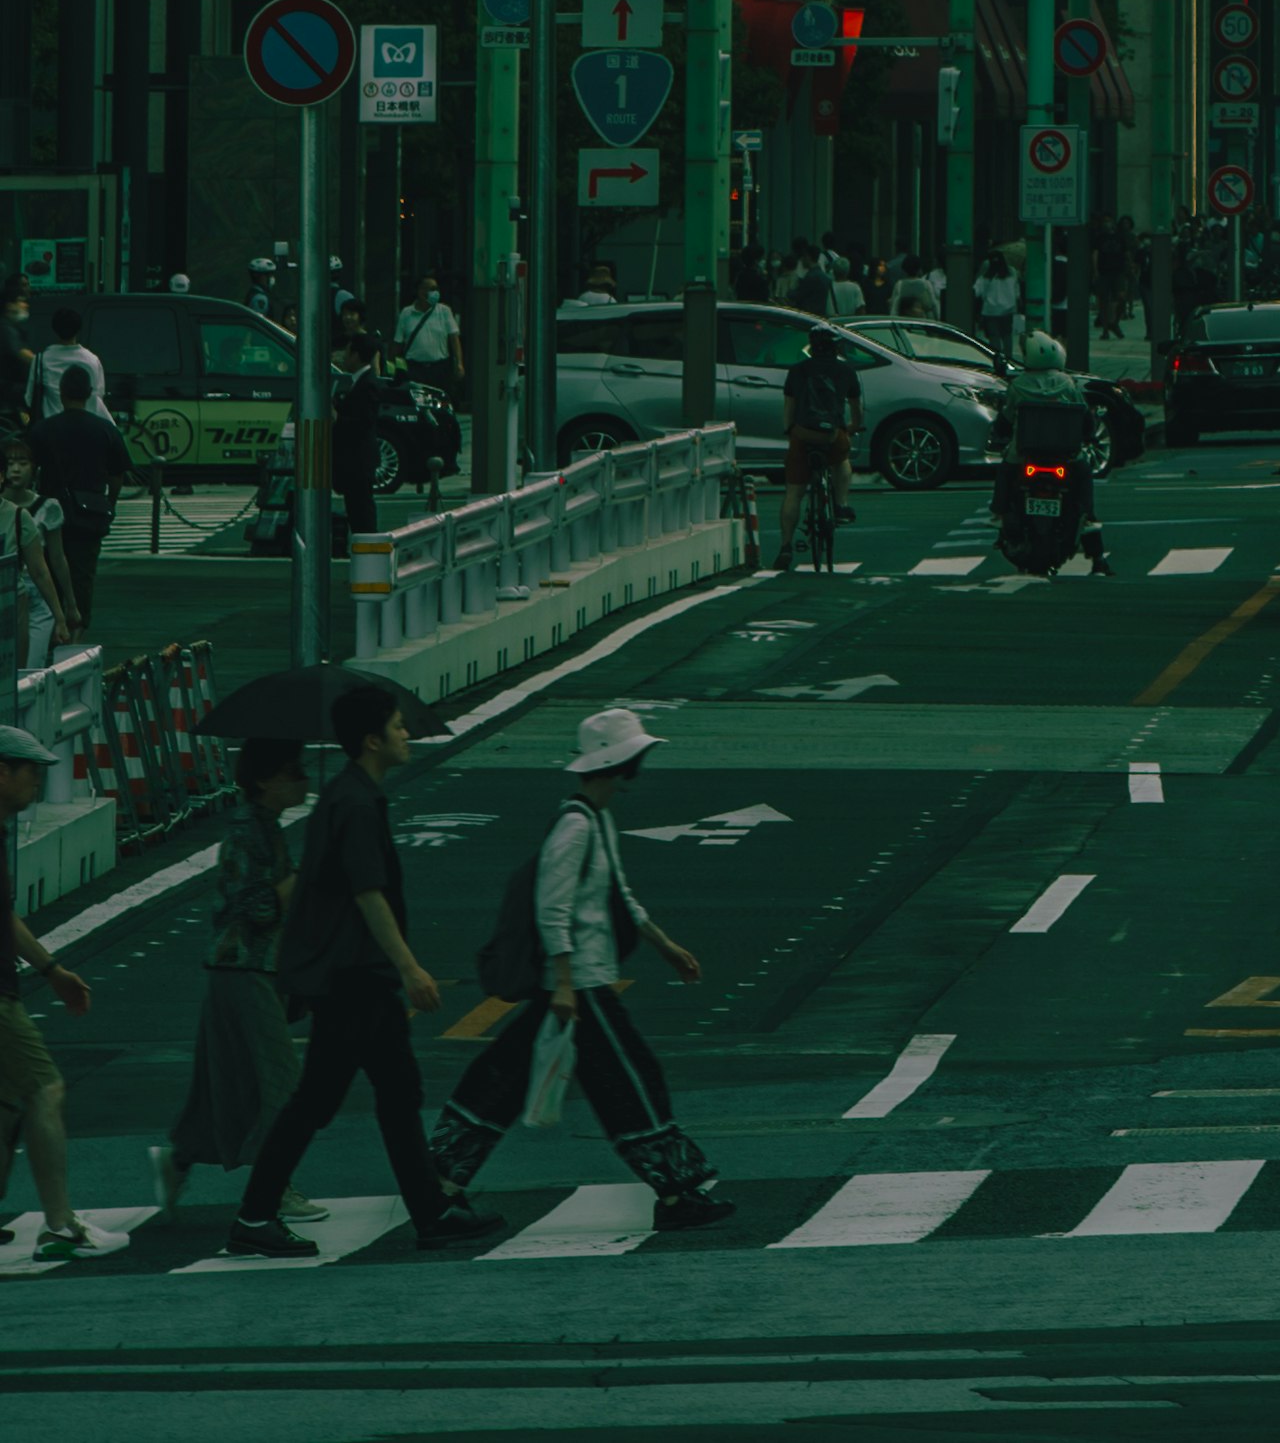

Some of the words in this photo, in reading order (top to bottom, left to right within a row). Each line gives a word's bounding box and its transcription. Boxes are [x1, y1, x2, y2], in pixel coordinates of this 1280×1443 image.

[1223, 16, 1250, 37] 50
[606, 54, 640, 69] 国道
[613, 75, 627, 109] 1
[376, 101, 421, 113] 日本橋駅
[606, 112, 637, 125] ROUTE
